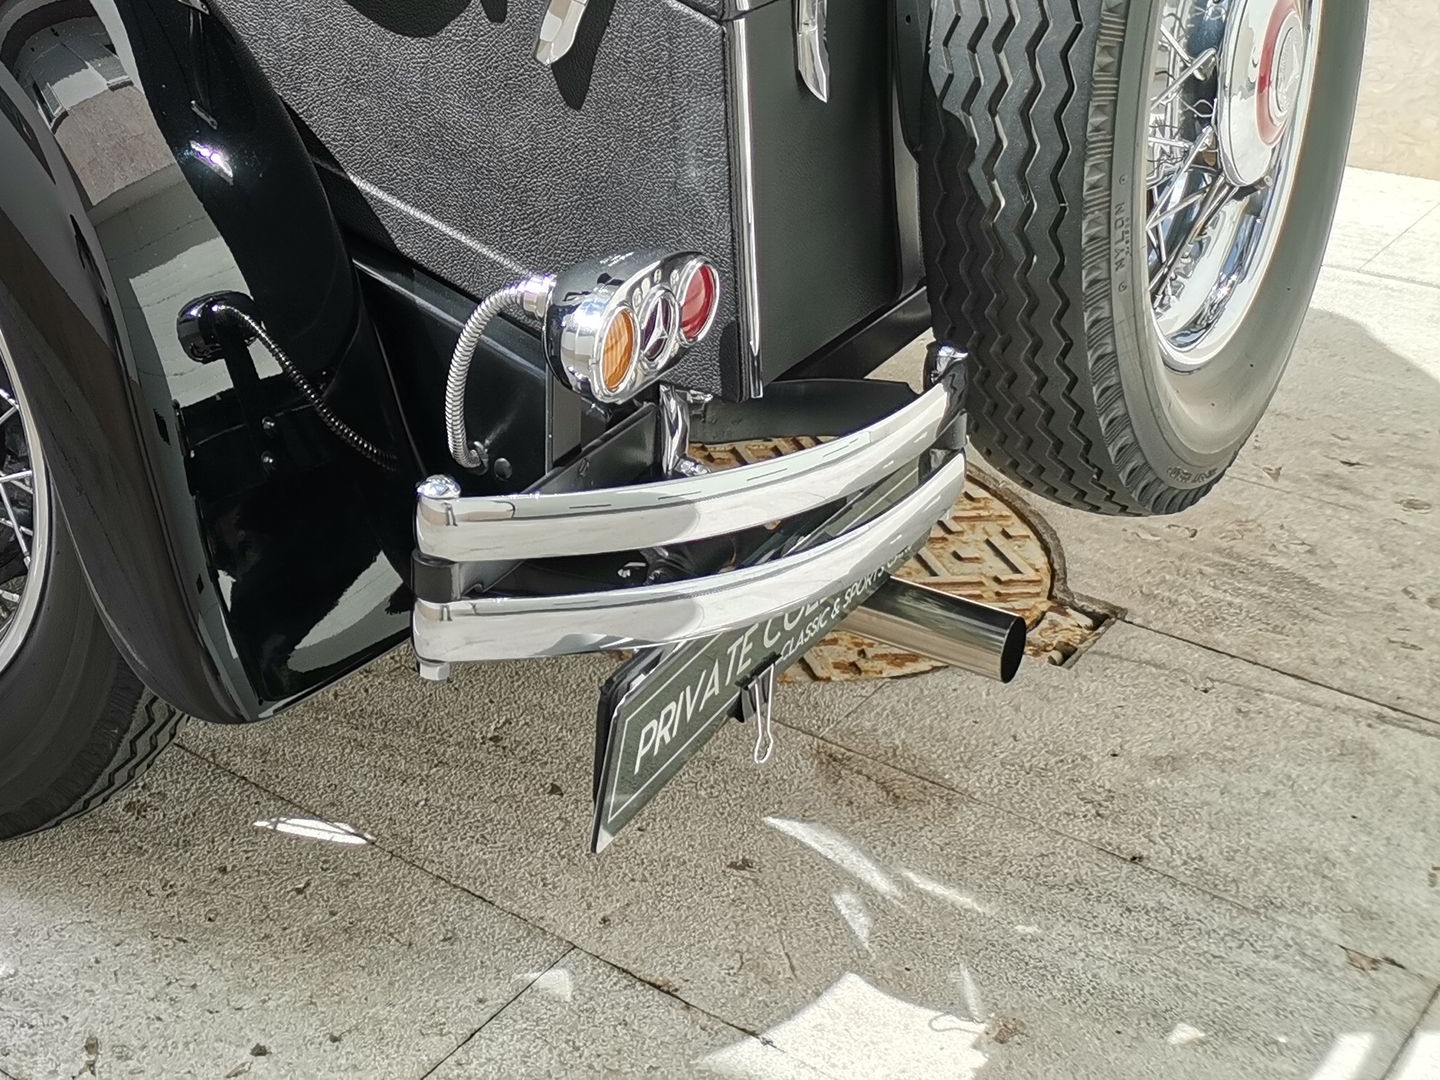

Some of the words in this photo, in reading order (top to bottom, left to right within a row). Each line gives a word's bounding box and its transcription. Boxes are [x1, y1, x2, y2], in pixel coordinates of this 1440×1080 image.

[780, 606, 831, 661] CLASSIC
[830, 597, 841, 619] &
[634, 622, 760, 775] PRIVATE
